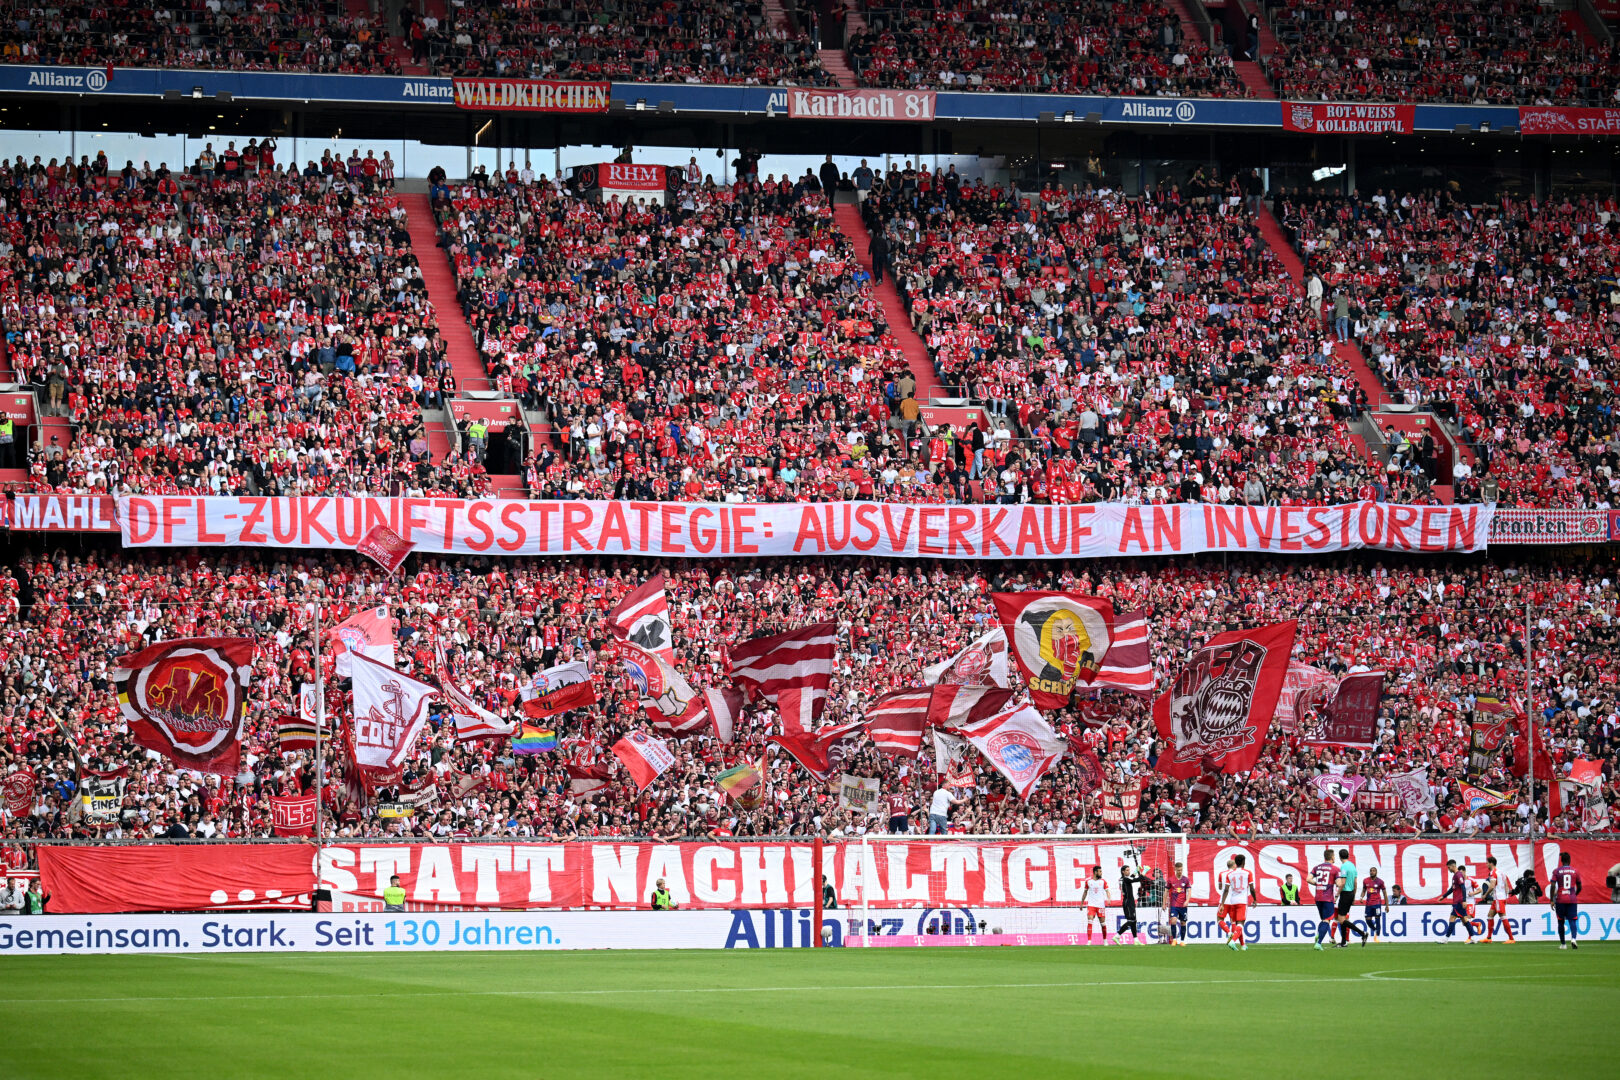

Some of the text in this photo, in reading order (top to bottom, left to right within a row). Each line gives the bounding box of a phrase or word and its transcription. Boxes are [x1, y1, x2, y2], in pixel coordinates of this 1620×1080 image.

[28, 71, 83, 87] Allianz
[455, 81, 607, 108] WALDKIRCHEN
[794, 91, 895, 118] Karbach
[1122, 102, 1173, 118] Allianz
[1326, 105, 1396, 119] ROT-WEISS
[1604, 110, 1620, 118] BA
[1316, 119, 1405, 133] KOLLBACHTAL
[609, 164, 658, 181] RHM
[5, 411, 27, 419] Arena
[14, 495, 111, 529] MAHL
[792, 503, 1096, 557] AUSVERKAUF
[1118, 505, 1182, 553] AN
[1202, 502, 1479, 552] INVESTOREN
[91, 798, 121, 811] EINER
[892, 797, 903, 808] 72
[311, 844, 565, 904] STATT
[1316, 870, 1330, 885] 23
[1563, 874, 1571, 889] 8
[1232, 875, 1244, 891] 11
[724, 909, 904, 949] Allianz
[1269, 912, 1316, 938] the
[0, 918, 561, 949] Gemeinsam. Stark. Seit 130 Jahren.
